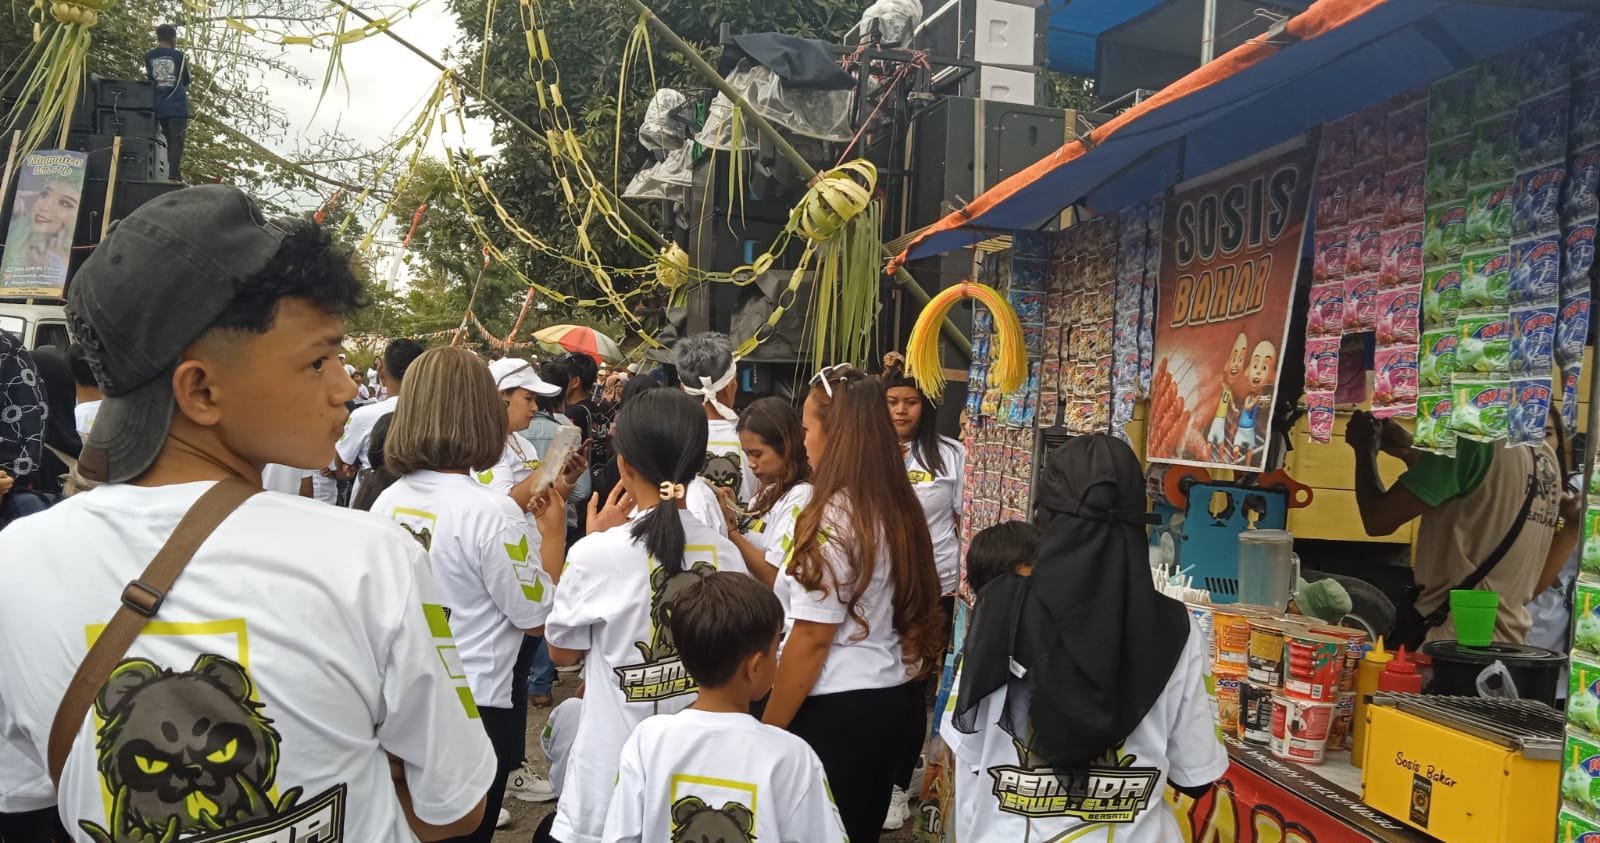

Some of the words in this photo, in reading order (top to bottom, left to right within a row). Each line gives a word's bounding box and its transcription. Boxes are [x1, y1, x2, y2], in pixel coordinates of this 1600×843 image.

[1176, 164, 1299, 267] SOSIS
[1169, 252, 1273, 328] BAKAR
[623, 660, 687, 687] PEM
[1395, 751, 1421, 773] Sosis
[1426, 764, 1458, 788] Bakar
[1087, 812, 1130, 820] BERSATU
